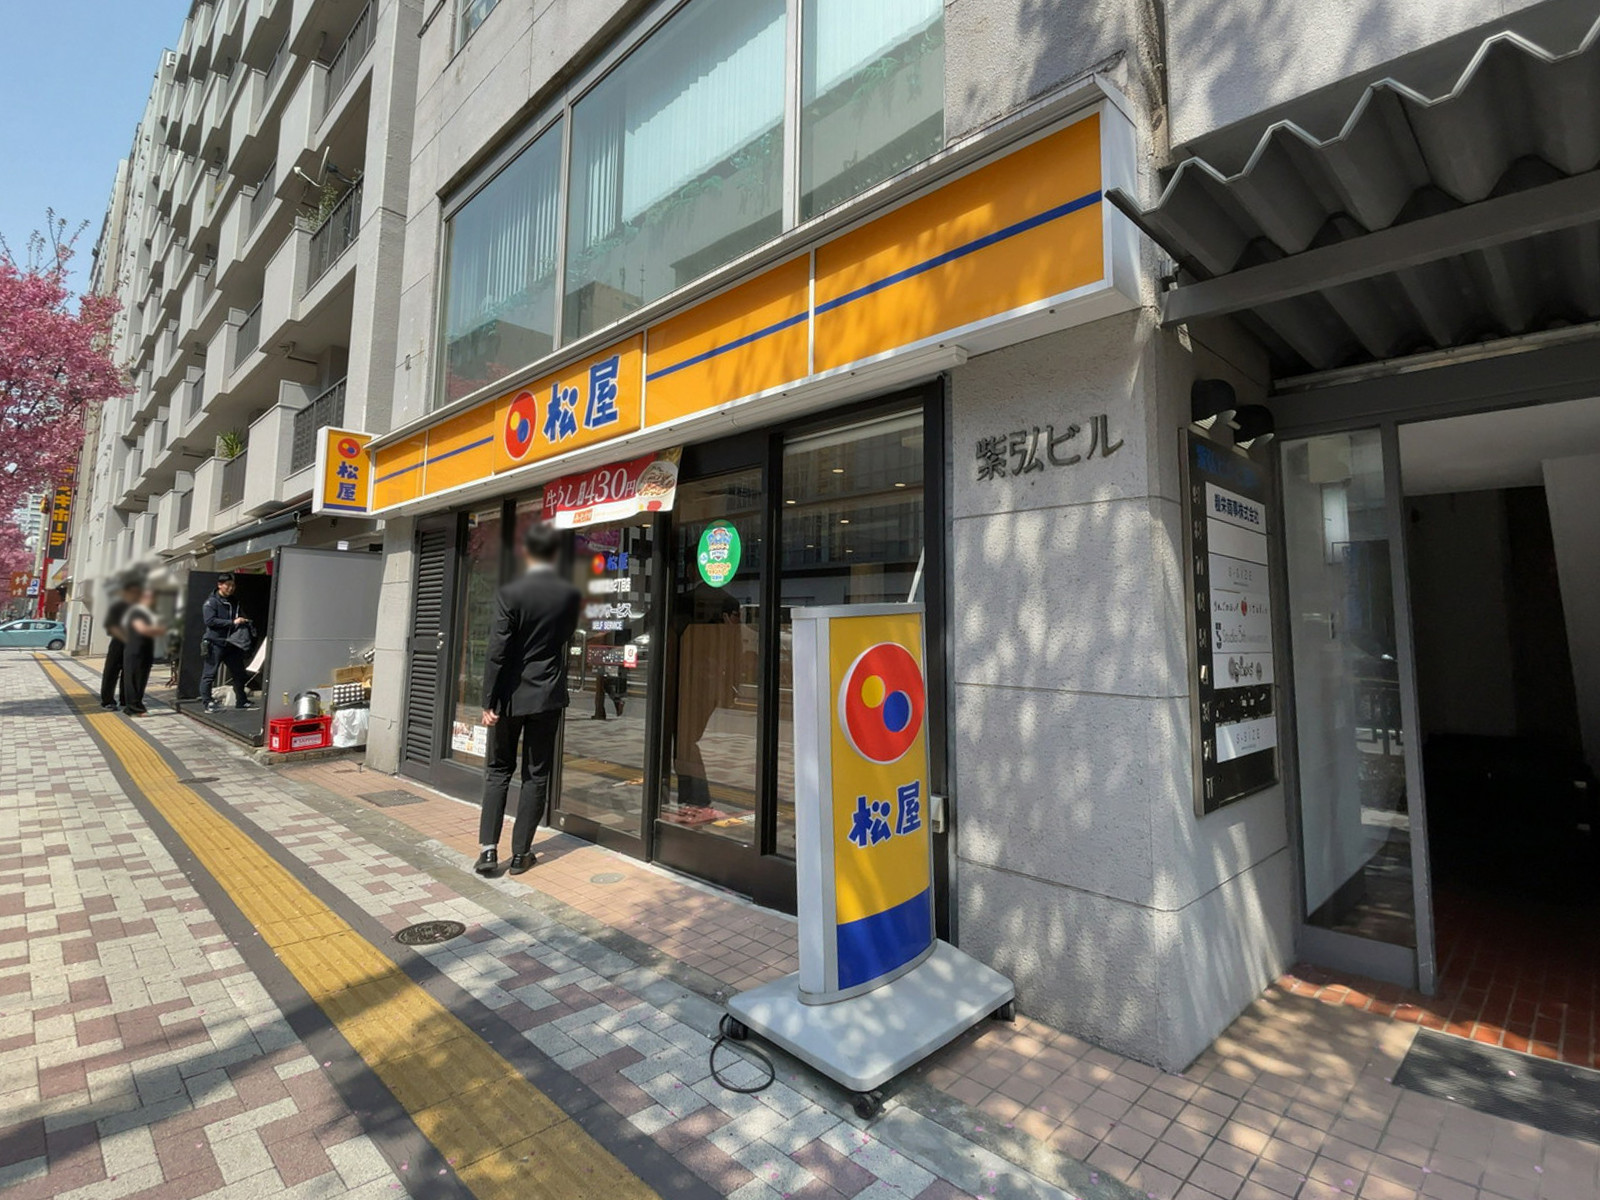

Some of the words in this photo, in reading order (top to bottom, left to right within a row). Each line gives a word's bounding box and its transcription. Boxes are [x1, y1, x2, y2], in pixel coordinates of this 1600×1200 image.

[542, 355, 621, 443] 松屋
[336, 461, 359, 501] 松屋
[975, 413, 1125, 482] 紫弘ビル
[848, 779, 922, 848] 松屋
